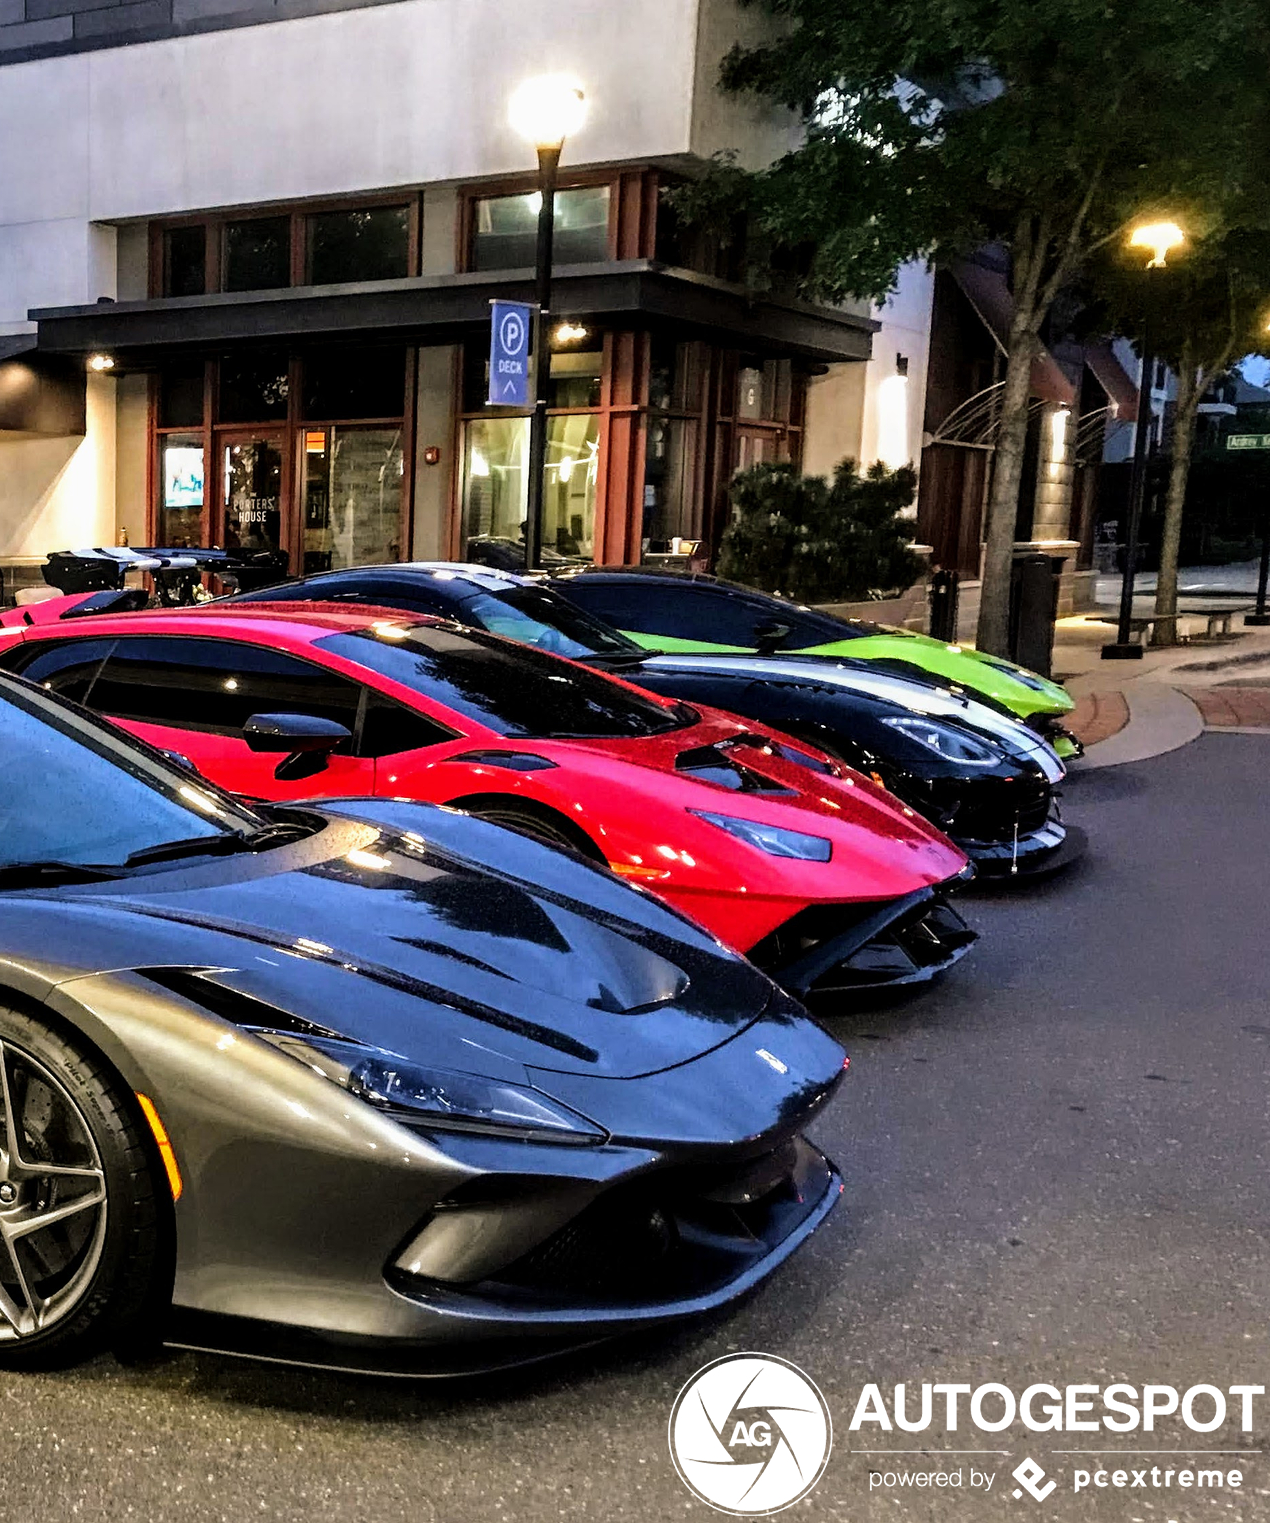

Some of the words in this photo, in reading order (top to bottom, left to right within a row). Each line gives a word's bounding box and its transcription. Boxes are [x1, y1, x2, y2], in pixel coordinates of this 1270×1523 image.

[506, 322, 519, 348] P
[498, 359, 523, 375] DECK
[238, 510, 267, 523] HOUSE
